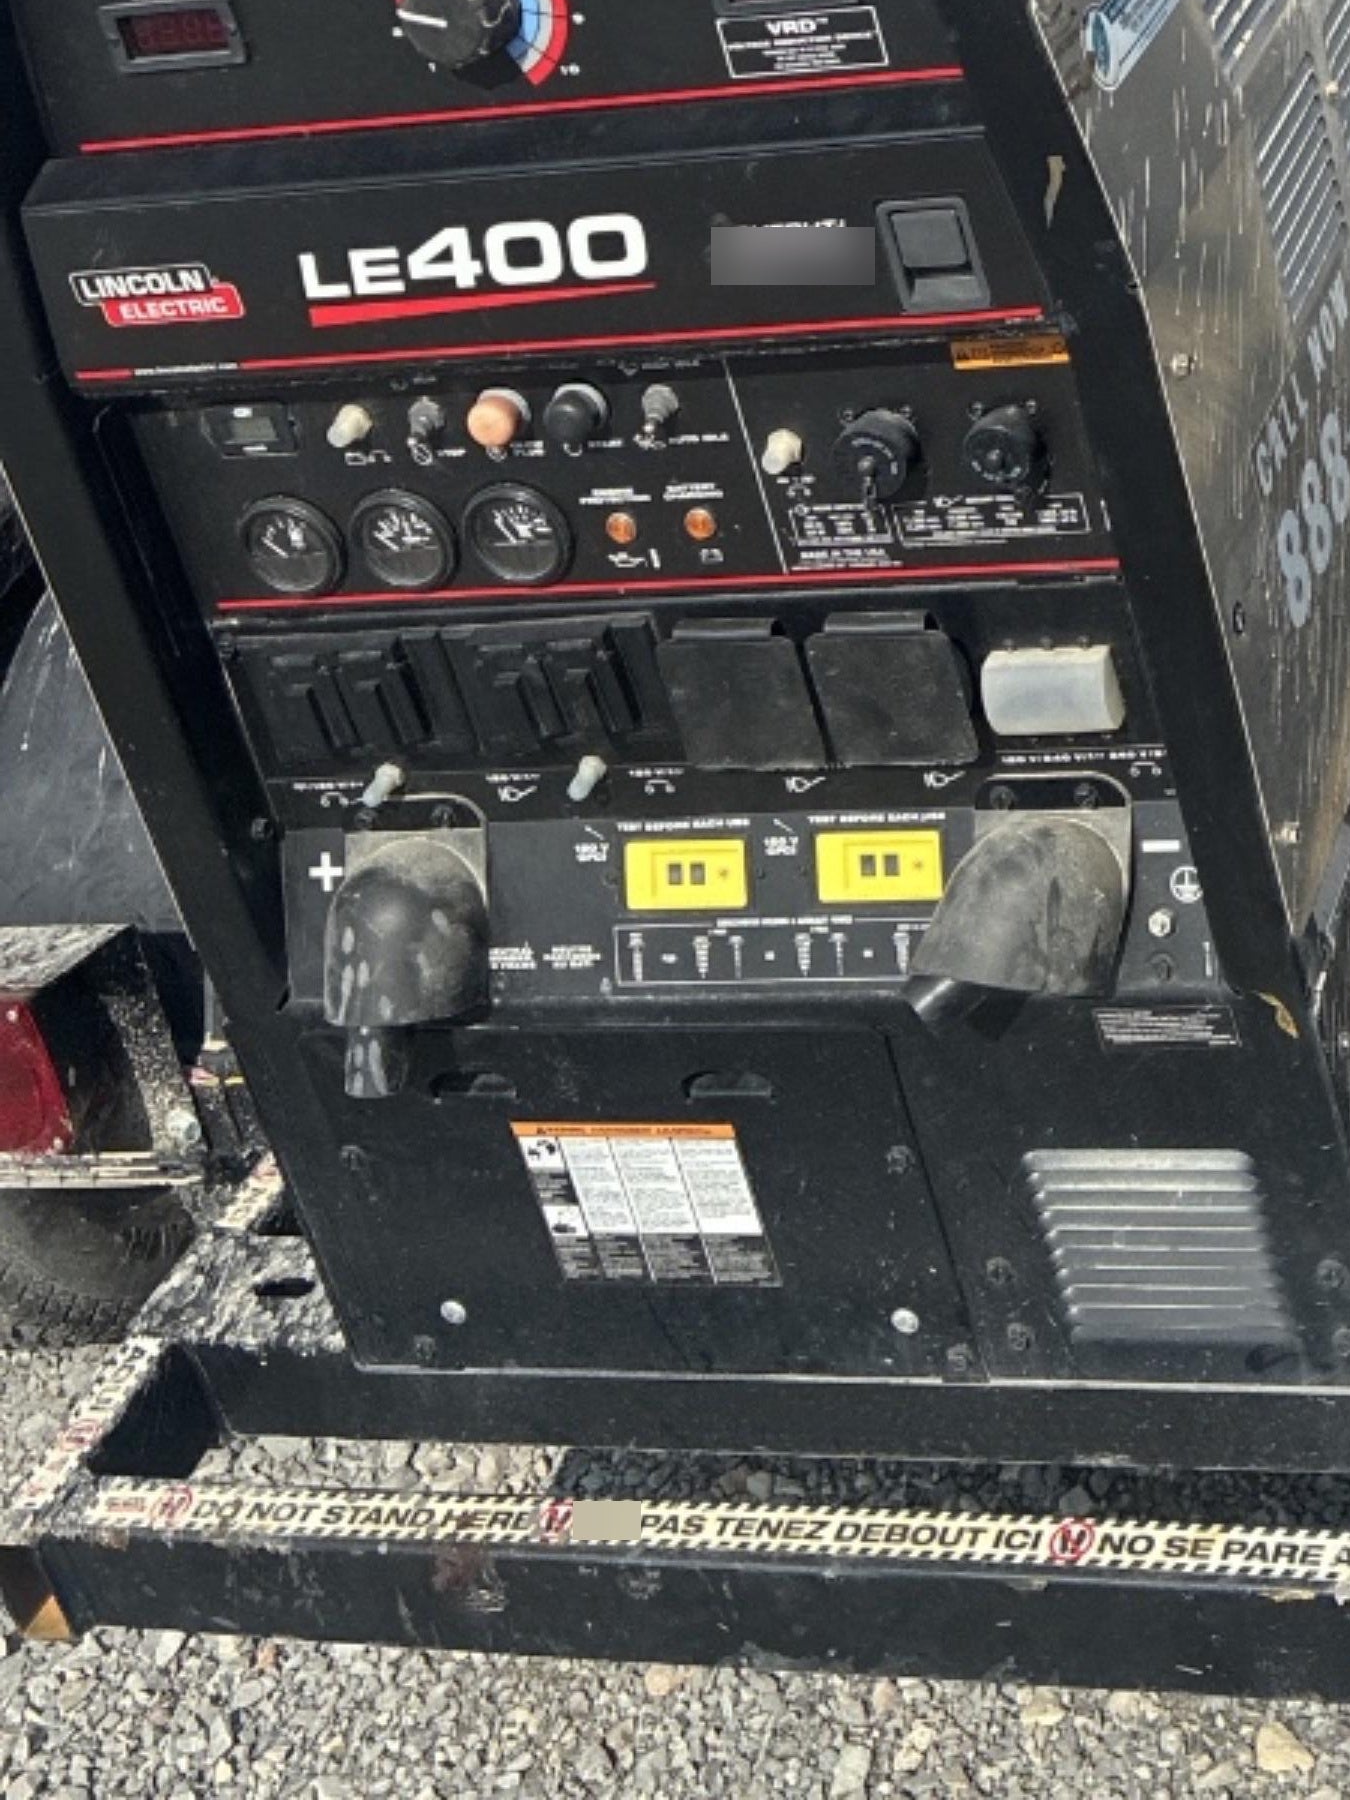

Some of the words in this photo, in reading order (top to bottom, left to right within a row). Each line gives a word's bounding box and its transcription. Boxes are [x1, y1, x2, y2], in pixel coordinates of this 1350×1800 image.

[298, 210, 649, 301] LE400
[78, 269, 205, 299] LINCOLN
[119, 296, 229, 320] ELECTRIC
[191, 1499, 242, 1523] DO
[244, 1500, 316, 1528] NOT
[319, 1503, 435, 1531] STAND
[439, 1508, 531, 1534] HERE
[640, 1513, 704, 1538] PAS
[714, 1515, 839, 1541] TENEZ
[833, 1521, 986, 1551] DEBOUT
[992, 1528, 1042, 1553] ICI
[1100, 1530, 1158, 1558] NO
[1162, 1535, 1216, 1560] SE
[1220, 1540, 1328, 1568] PARE
